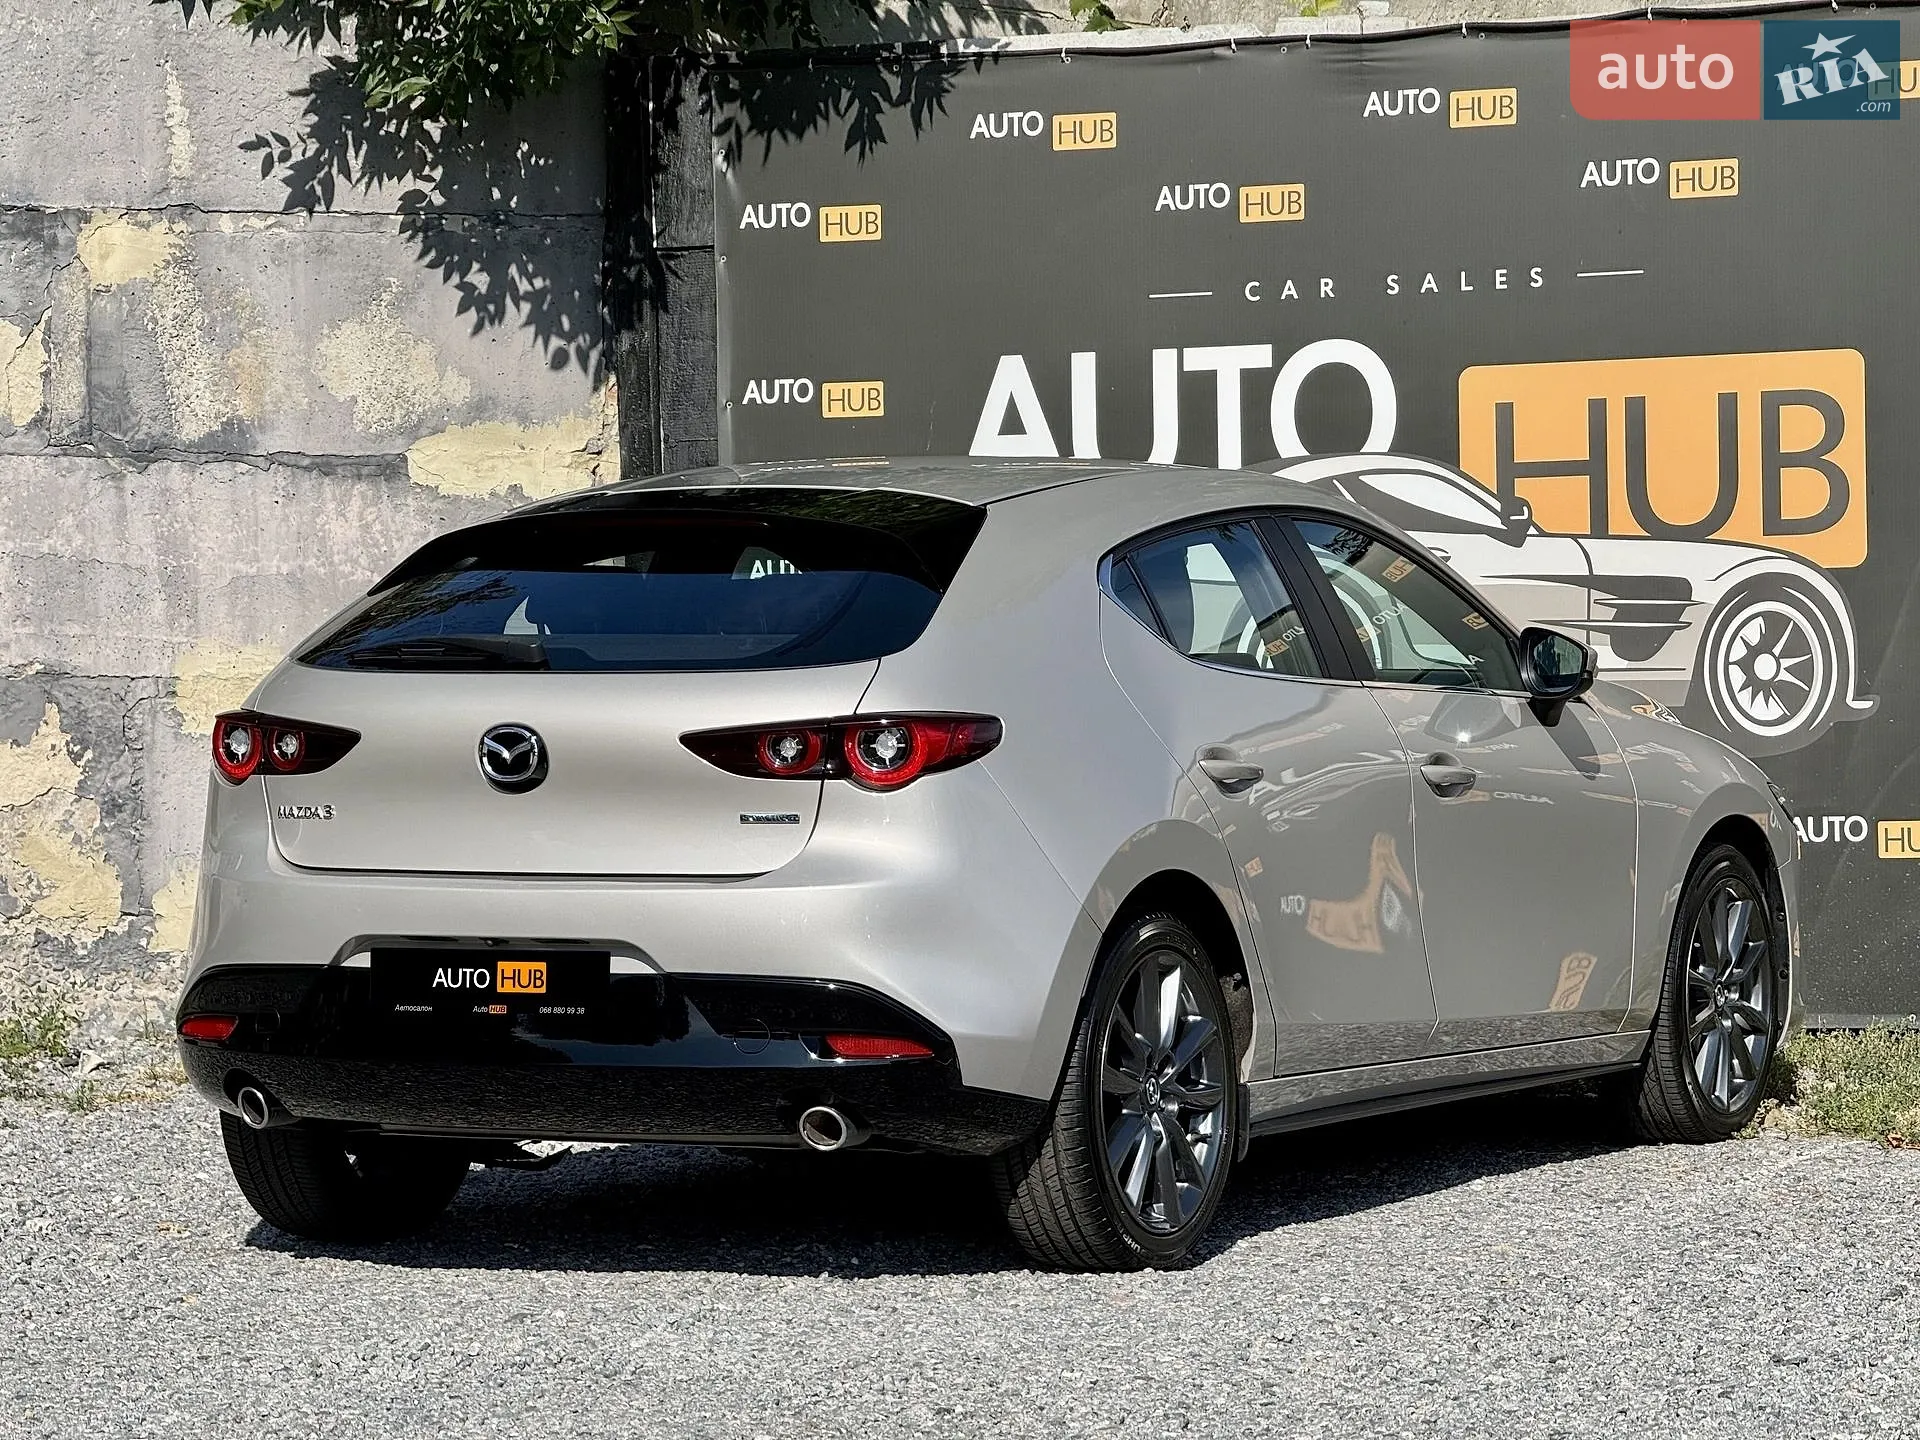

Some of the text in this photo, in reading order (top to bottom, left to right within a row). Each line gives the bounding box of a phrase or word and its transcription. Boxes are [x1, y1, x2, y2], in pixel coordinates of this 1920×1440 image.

[1874, 66, 1920, 95] HU
[1362, 87, 1514, 122] AUTO HUB
[970, 111, 1113, 146] AUTO HUB
[1580, 157, 1736, 193] AUTO HUB
[1155, 183, 1302, 217] AUTO HUB
[740, 202, 879, 237] AUTO HUB
[1245, 267, 1544, 301] CAR SALES
[742, 378, 882, 412] AUTO HUB
[969, 338, 1851, 538] AUTO HUB
[1793, 815, 1868, 842] AUTO
[1884, 827, 1920, 853] HU
[432, 968, 545, 989] AUTO HUB
[473, 1005, 507, 1013] Auto HUB
[539, 1006, 552, 1014] 068
[553, 1006, 565, 1014] 880
[576, 1007, 585, 1015] 38
